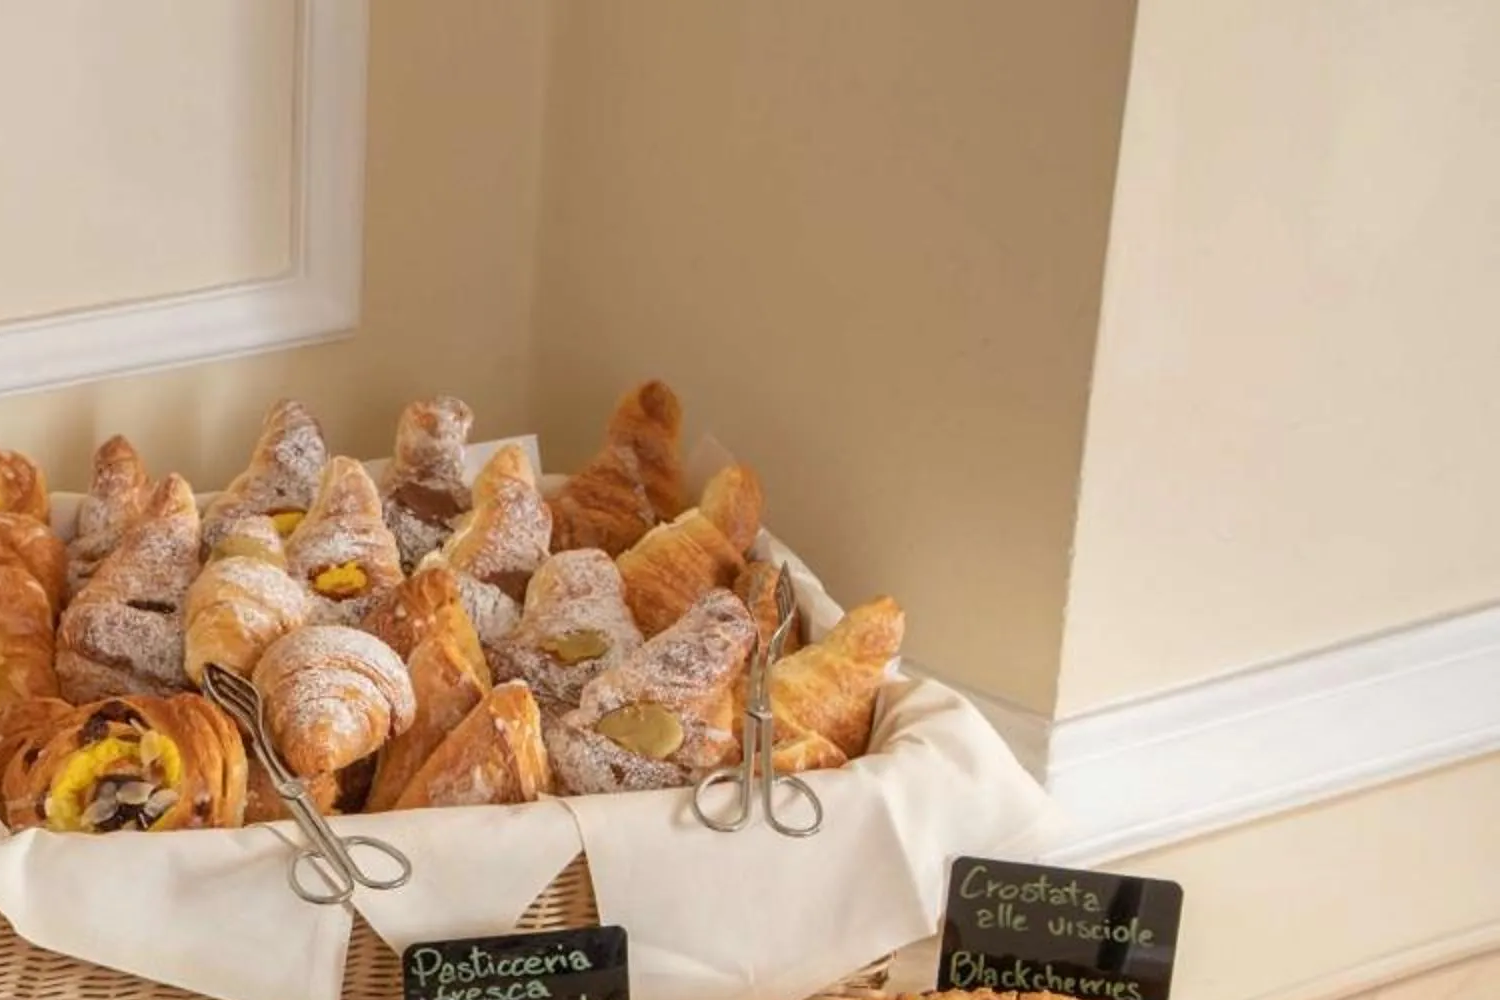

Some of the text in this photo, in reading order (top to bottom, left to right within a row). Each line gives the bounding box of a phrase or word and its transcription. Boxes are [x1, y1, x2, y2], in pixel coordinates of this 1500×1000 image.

[959, 864, 1102, 912] Crostata
[975, 903, 1030, 932] alle
[411, 944, 593, 987] Pasticceria
